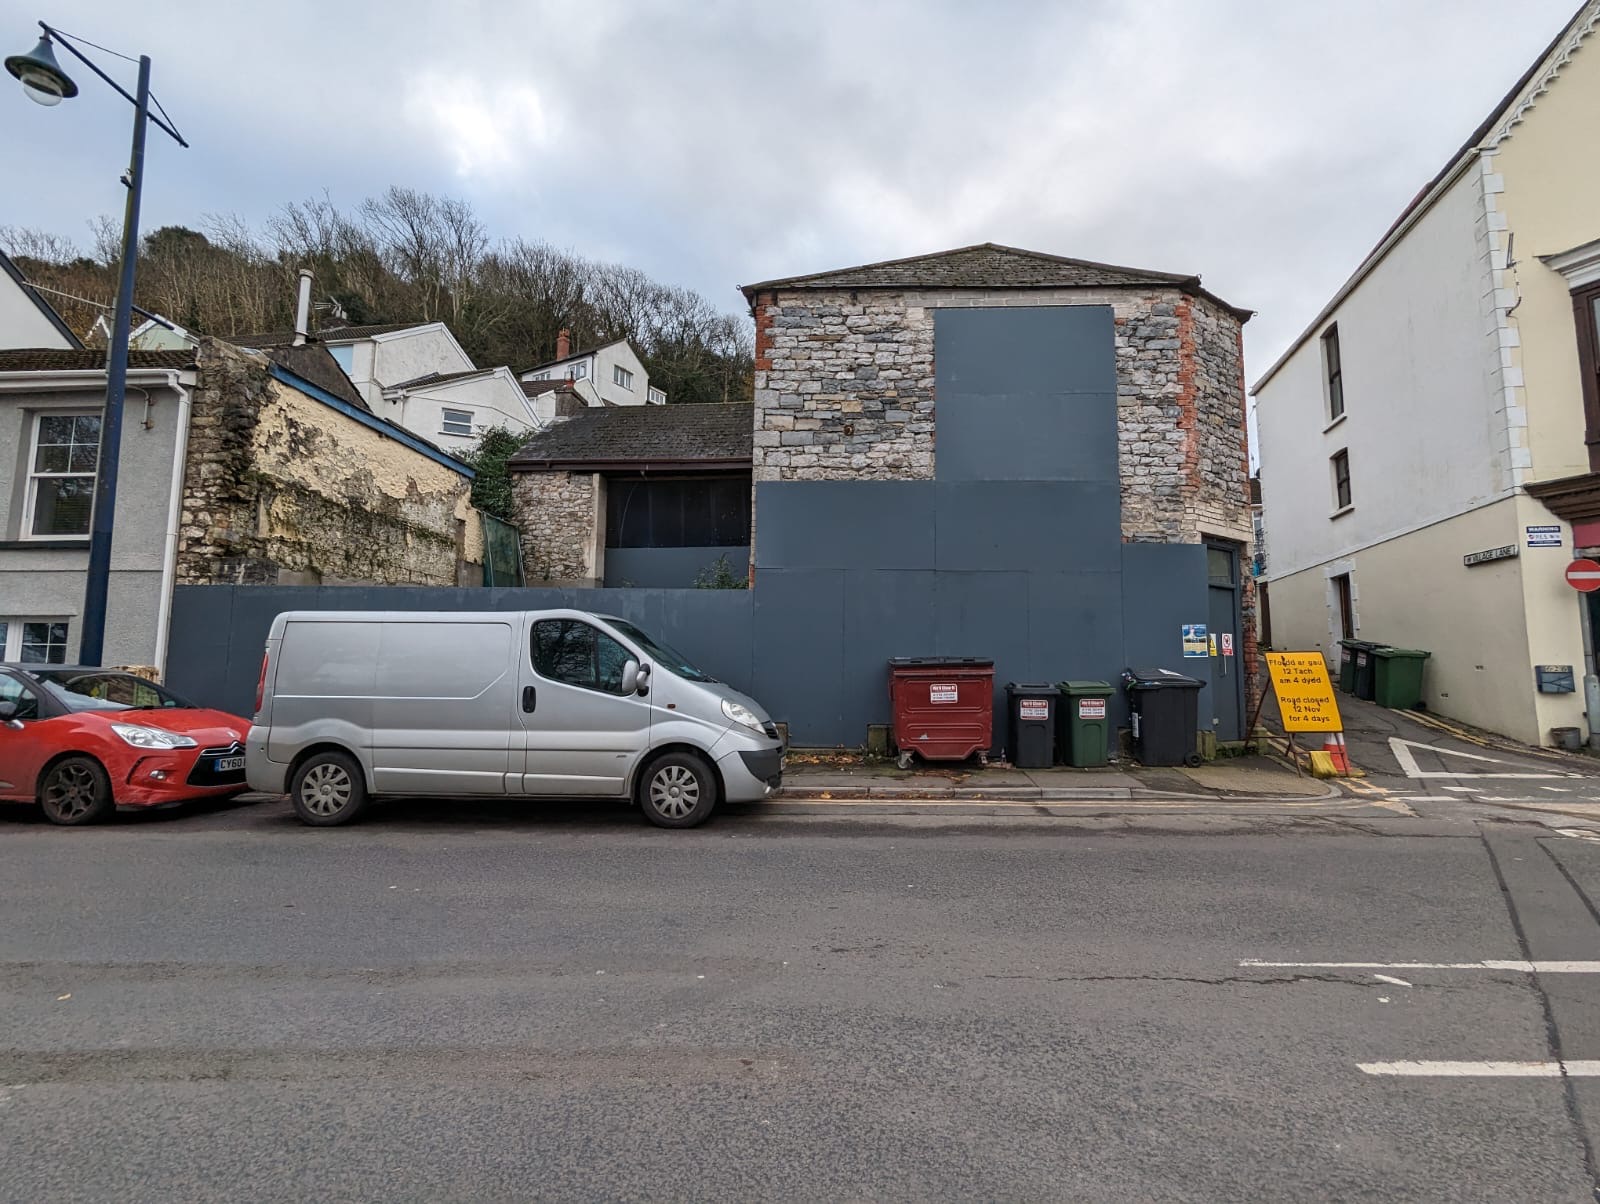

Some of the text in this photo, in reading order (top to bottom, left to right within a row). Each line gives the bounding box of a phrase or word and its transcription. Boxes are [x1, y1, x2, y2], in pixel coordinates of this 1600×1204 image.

[1472, 547, 1511, 562] VILLAGE LANE
[1311, 715, 1330, 723] days
[221, 759, 242, 769] CY60
